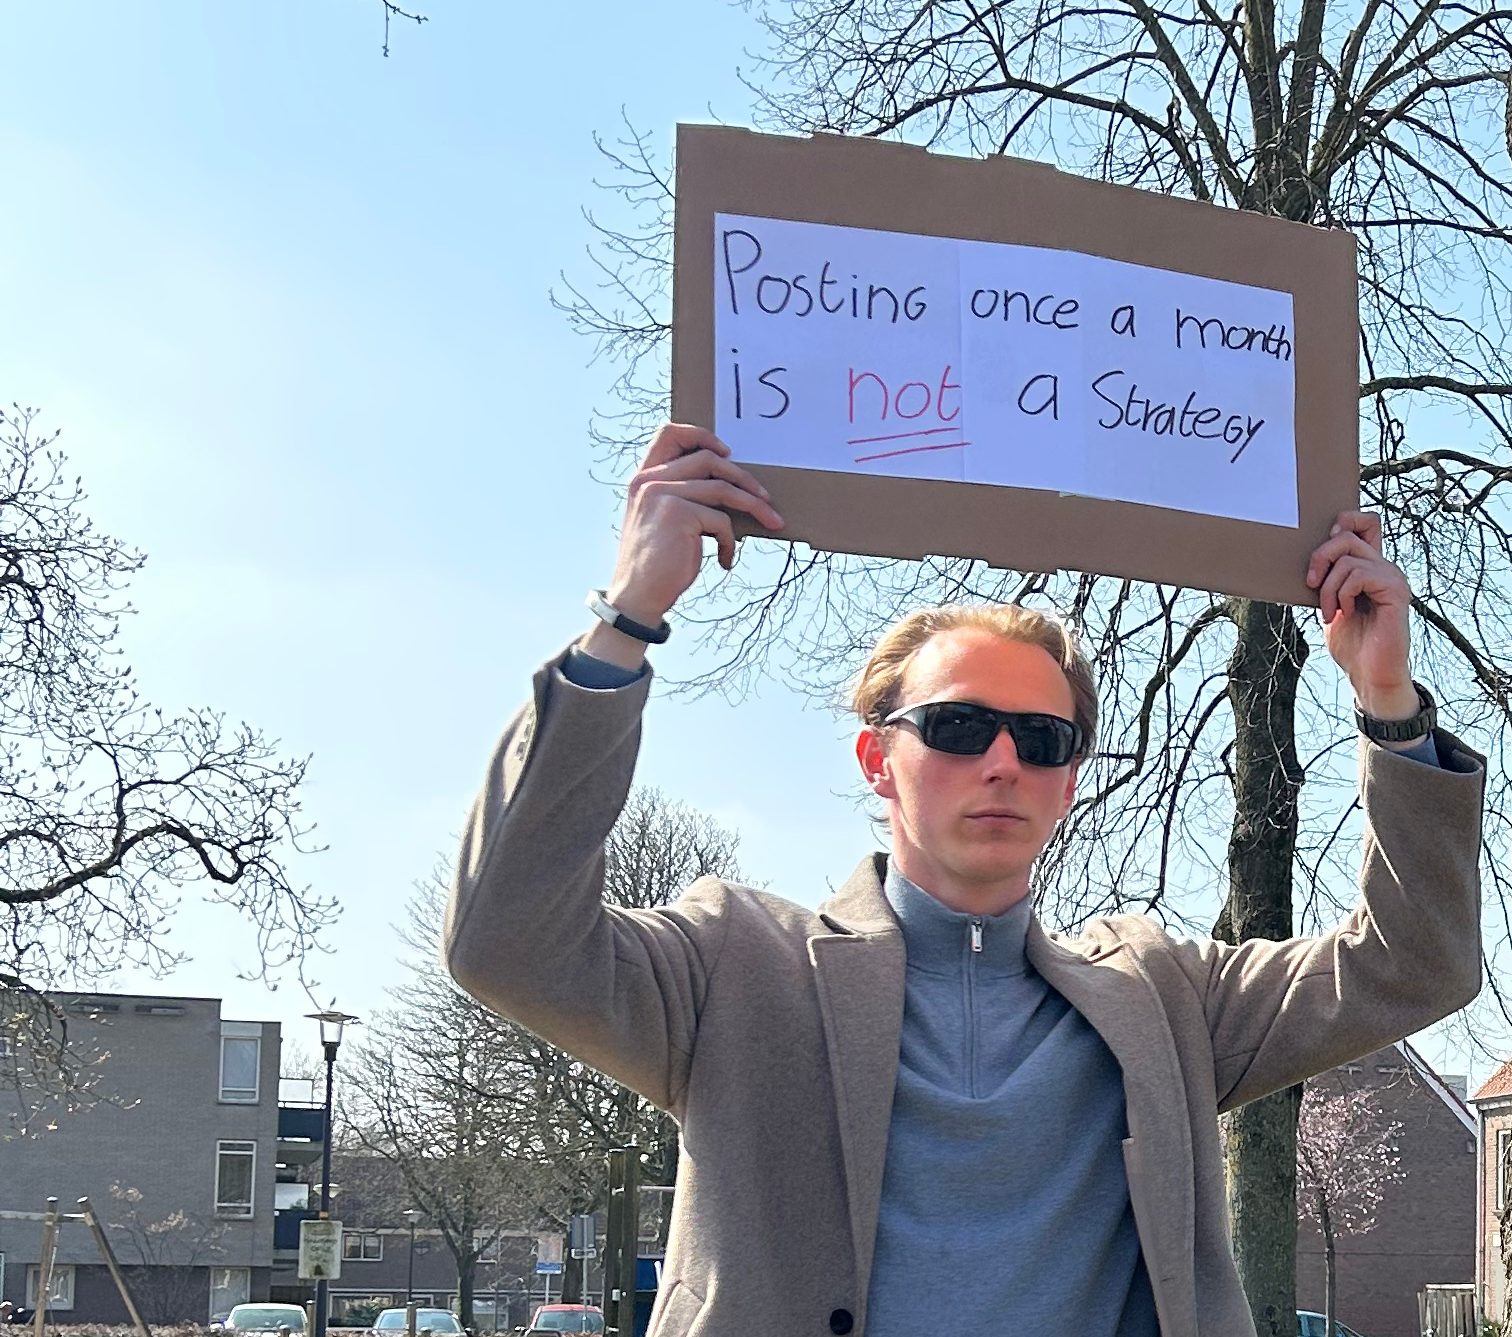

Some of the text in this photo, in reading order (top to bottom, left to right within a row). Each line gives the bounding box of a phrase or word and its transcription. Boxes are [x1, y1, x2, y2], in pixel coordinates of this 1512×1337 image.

[970, 288, 1080, 330] once
[1110, 304, 1136, 338] a
[1175, 307, 1292, 361] month
[731, 348, 790, 420] is
[848, 364, 961, 425] not
[1017, 373, 1059, 421] a
